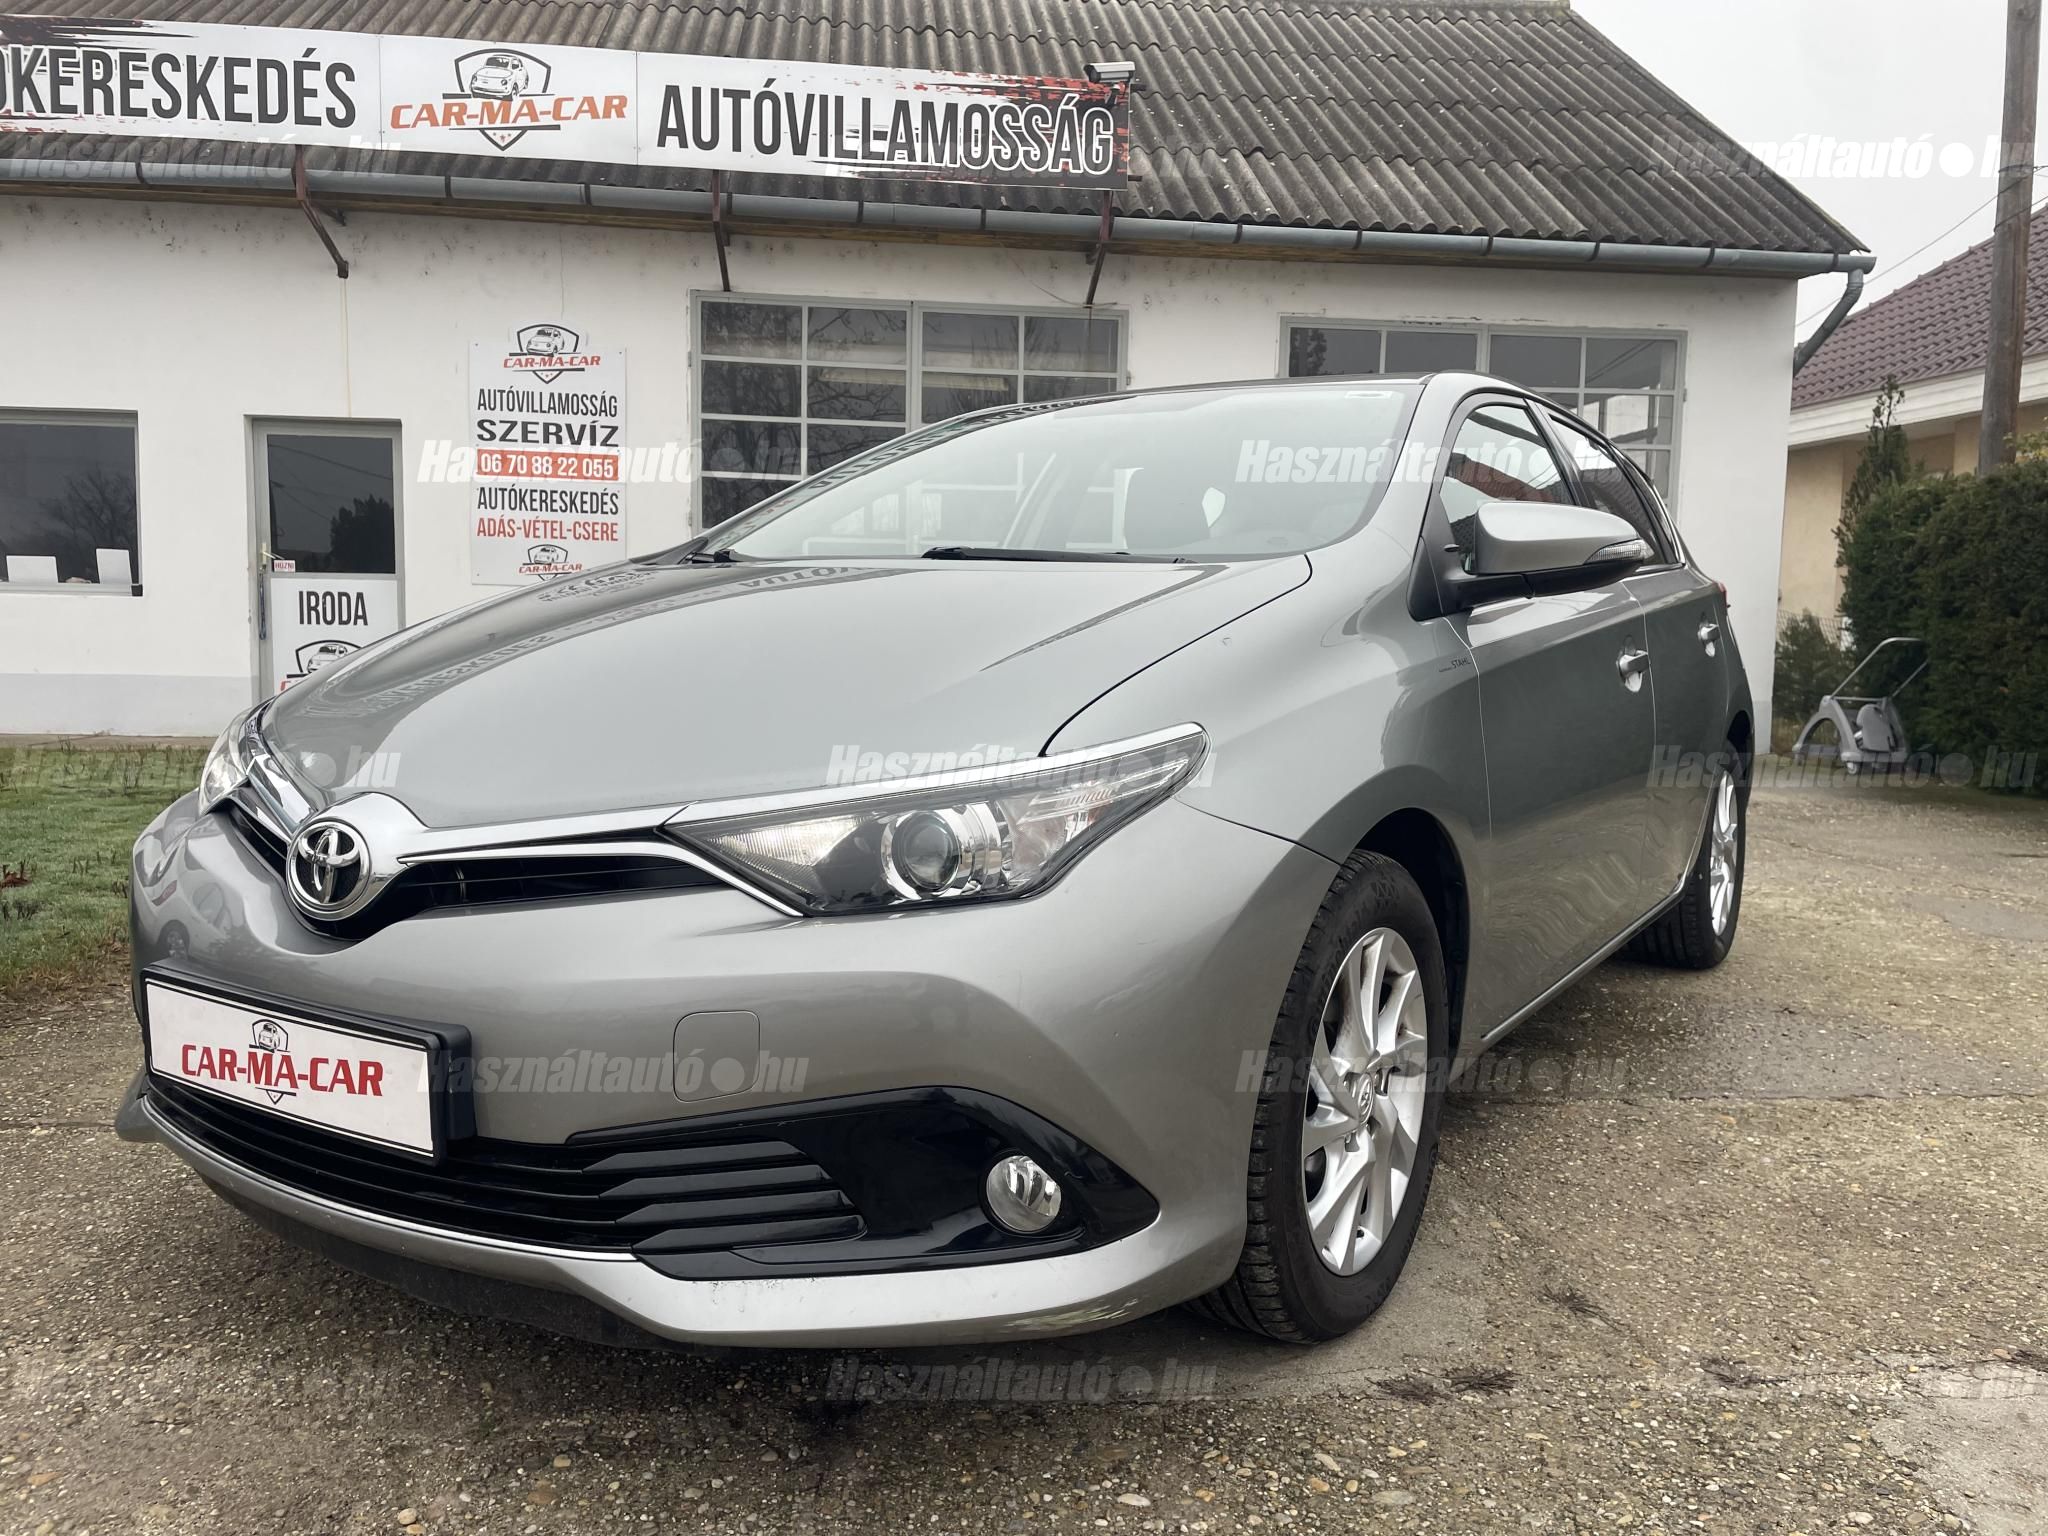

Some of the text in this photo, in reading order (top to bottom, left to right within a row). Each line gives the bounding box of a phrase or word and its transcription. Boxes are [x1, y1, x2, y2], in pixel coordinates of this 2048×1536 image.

[0, 45, 356, 128] KERESKEDÉS
[390, 95, 628, 130] CAR-MA-CAR
[656, 77, 1114, 175] AUTÓVILLAMOSSÁG
[503, 355, 601, 369] CAR-MA-CAR
[477, 386, 618, 417] AUTÓVILLAMOSSÁG
[476, 418, 619, 447] SZERVÍZ
[480, 453, 614, 478] 06 70 88 22 055
[477, 484, 619, 515] AUTÓKERESKEDÉS
[476, 514, 619, 541] ADÁS-VÉTEL-CSERE
[518, 562, 583, 574] CAR-MA-CAR
[298, 590, 369, 626] IRODA
[181, 1043, 384, 1097] CAR-MA-CAR
